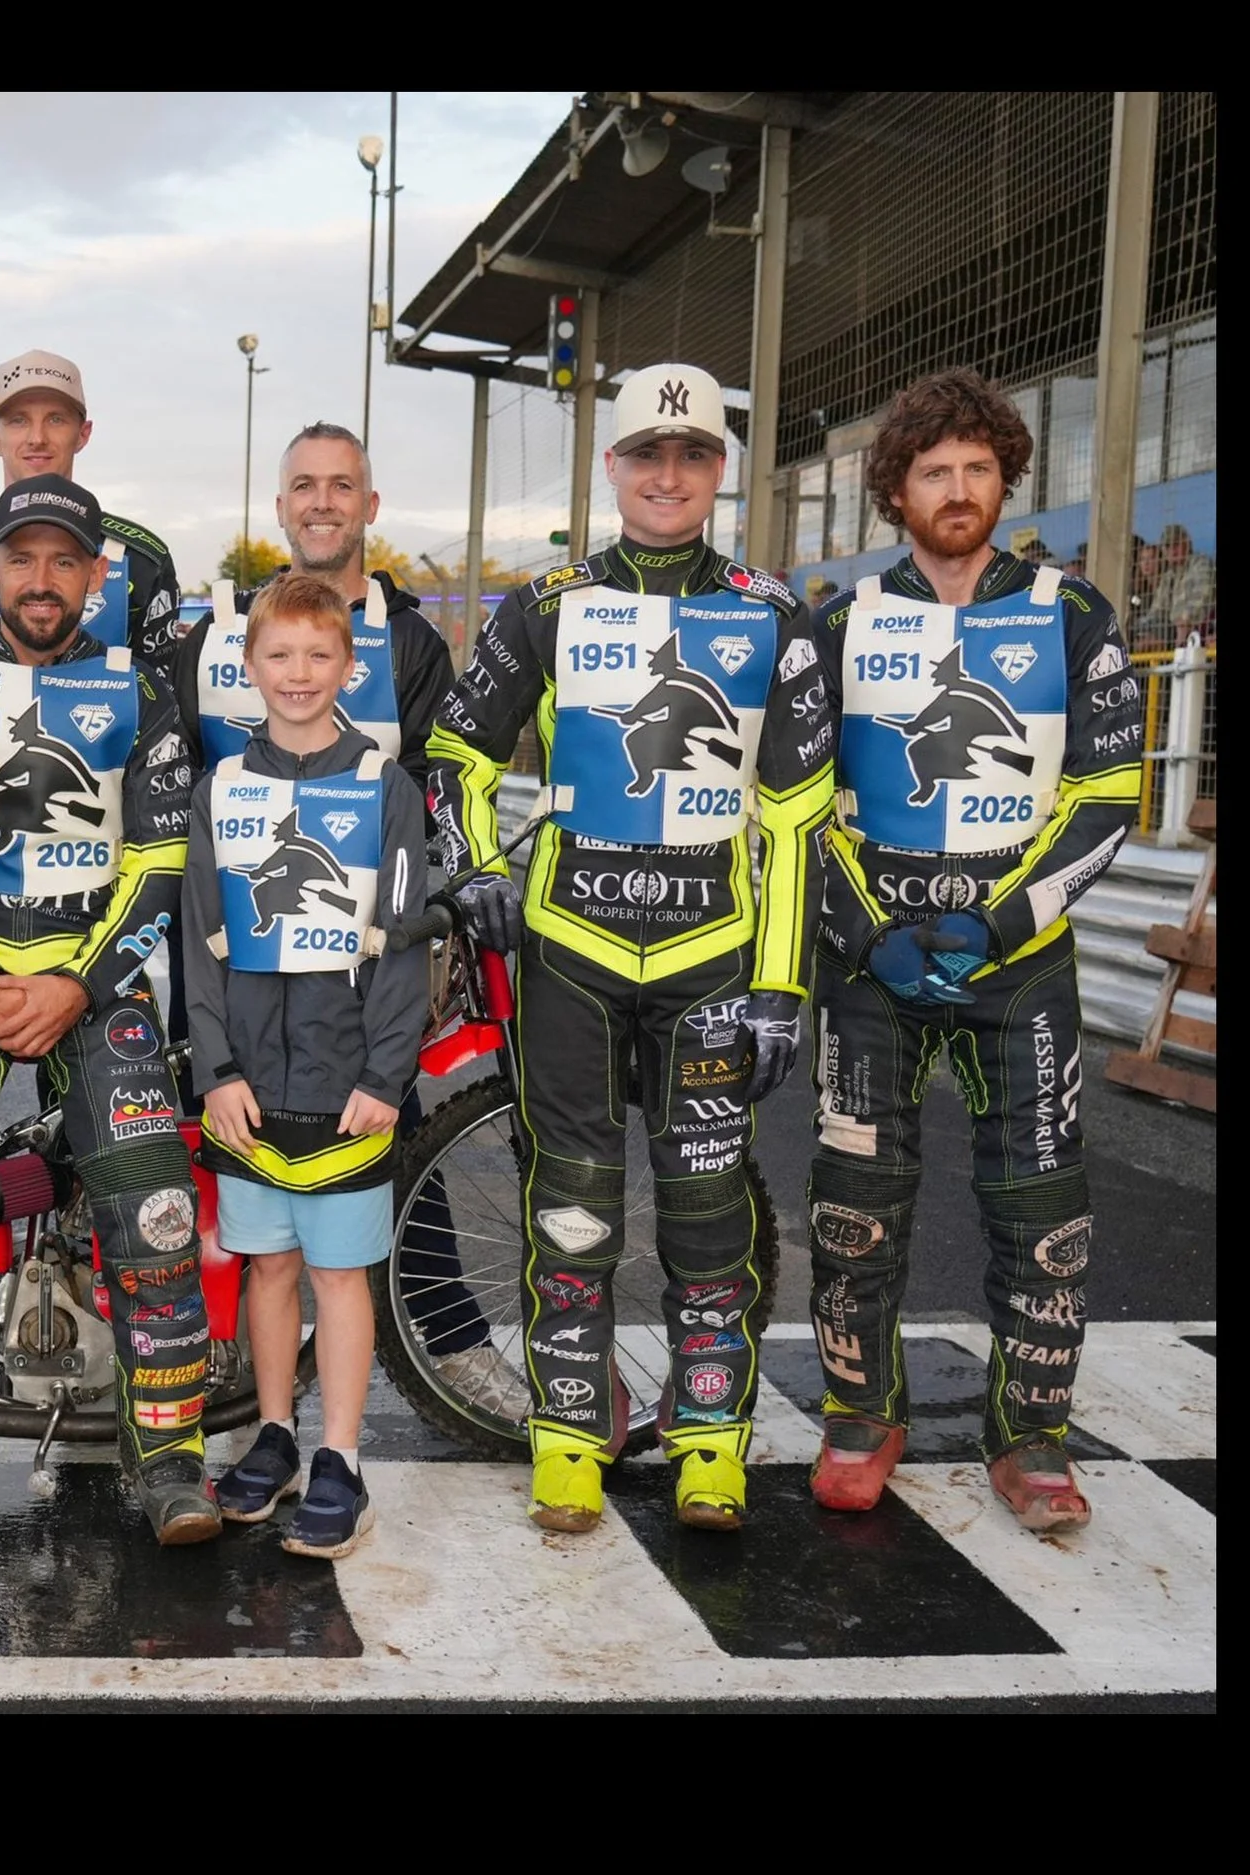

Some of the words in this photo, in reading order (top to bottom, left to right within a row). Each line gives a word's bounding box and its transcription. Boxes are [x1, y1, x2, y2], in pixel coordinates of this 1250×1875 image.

[24, 367, 73, 384] TEXOM
[750, 586, 770, 596] LTD
[753, 572, 789, 594] VISION
[583, 606, 639, 619] ROWE
[679, 606, 768, 621] PREMIERSHIP
[871, 615, 925, 631] ROWE
[963, 615, 1055, 629] PREMIERSHIP
[225, 634, 246, 645] RO
[568, 643, 637, 672] 1951
[854, 652, 921, 682] 1951
[40, 674, 131, 690] PREMIERSHIP
[208, 663, 252, 688] 195
[459, 676, 482, 700] GROUP
[1091, 676, 1139, 714] SCO
[150, 764, 192, 796] SCO
[228, 786, 271, 799] ROWE
[299, 787, 376, 800] PREMIERSHIP
[677, 786, 742, 816] 2026
[153, 808, 192, 830] MAY
[960, 795, 1034, 824] 2026
[215, 816, 266, 841] 1951
[36, 841, 109, 868] 2026
[1046, 845, 1116, 905] Topclass
[571, 868, 717, 907] SCOTT
[877, 873, 1000, 911] SCOT
[583, 904, 651, 924] PROPERTY
[655, 910, 702, 923] GROUP
[292, 927, 360, 954] 2026
[680, 1053, 752, 1075] STAA
[295, 1114, 327, 1124] GROUP
[536, 1273, 570, 1300] MICK
[152, 1335, 191, 1348] Darcey
[1004, 1336, 1071, 1366] TEAM
[695, 1373, 721, 1392] STS
